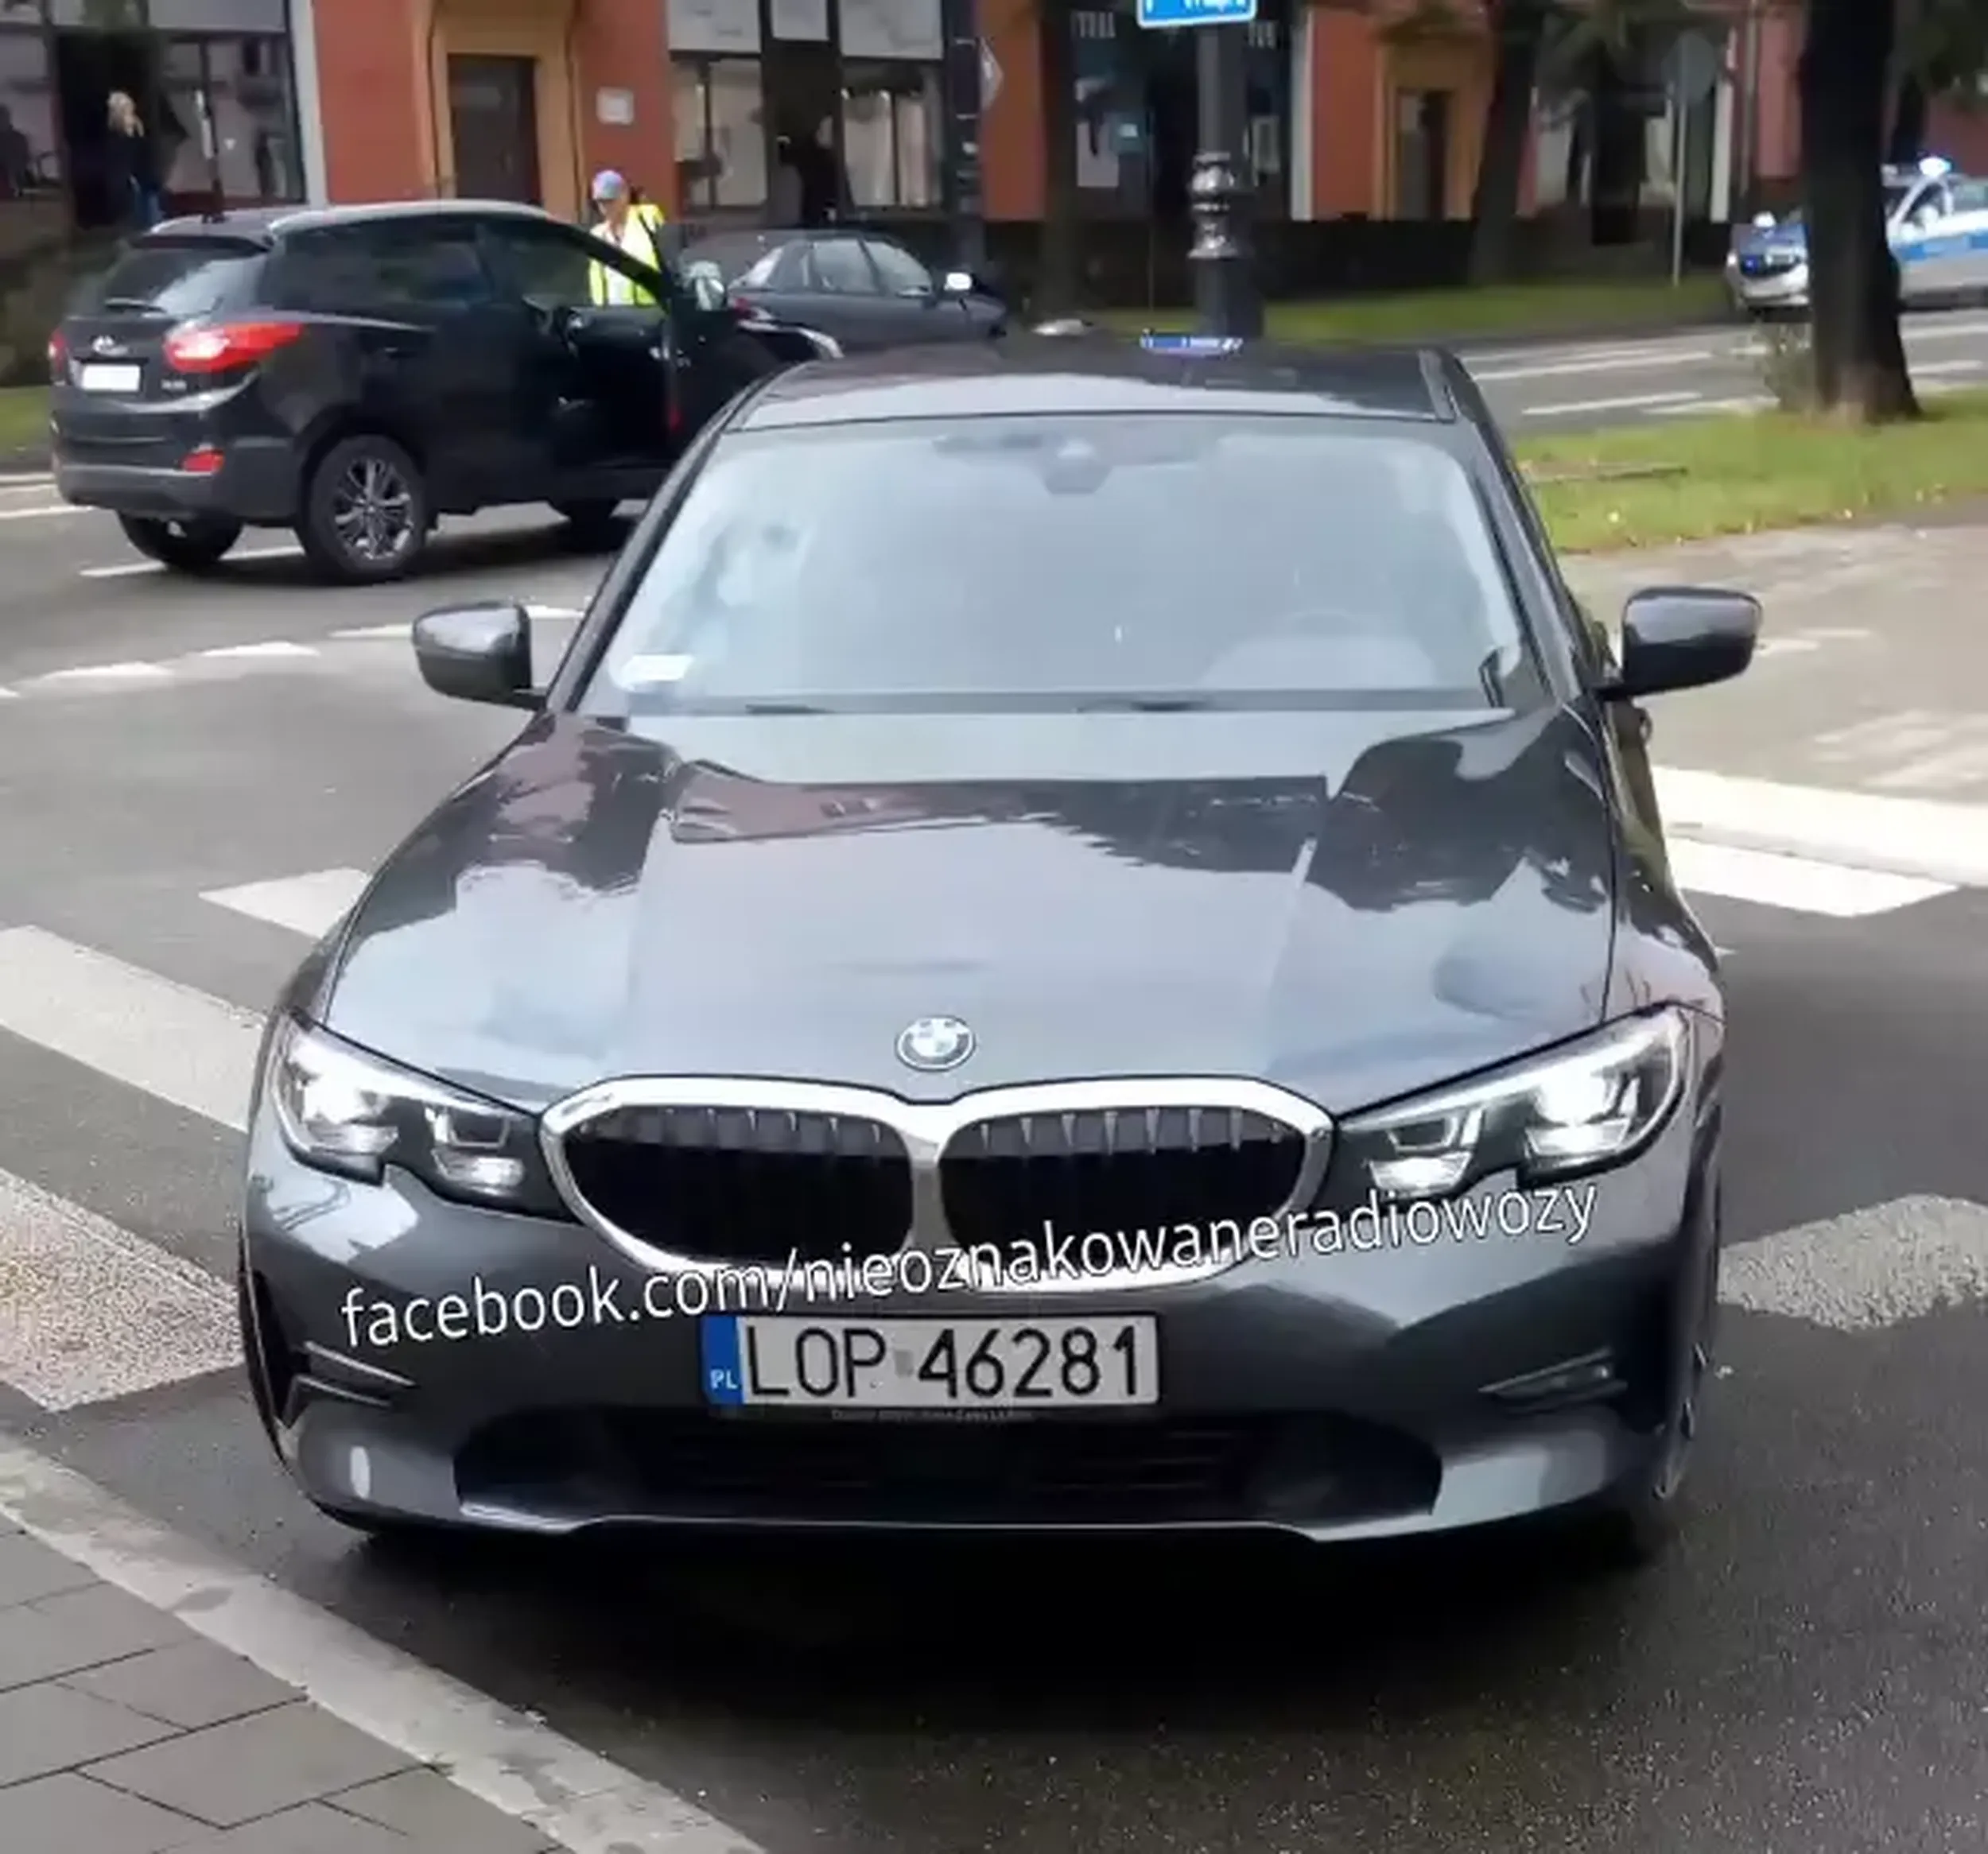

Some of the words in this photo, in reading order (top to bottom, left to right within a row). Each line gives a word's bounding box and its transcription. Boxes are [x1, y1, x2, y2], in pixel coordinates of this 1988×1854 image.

[709, 1368, 738, 1390] PL
[747, 1326, 887, 1397] LOP
[918, 1325, 1136, 1398] 46281
